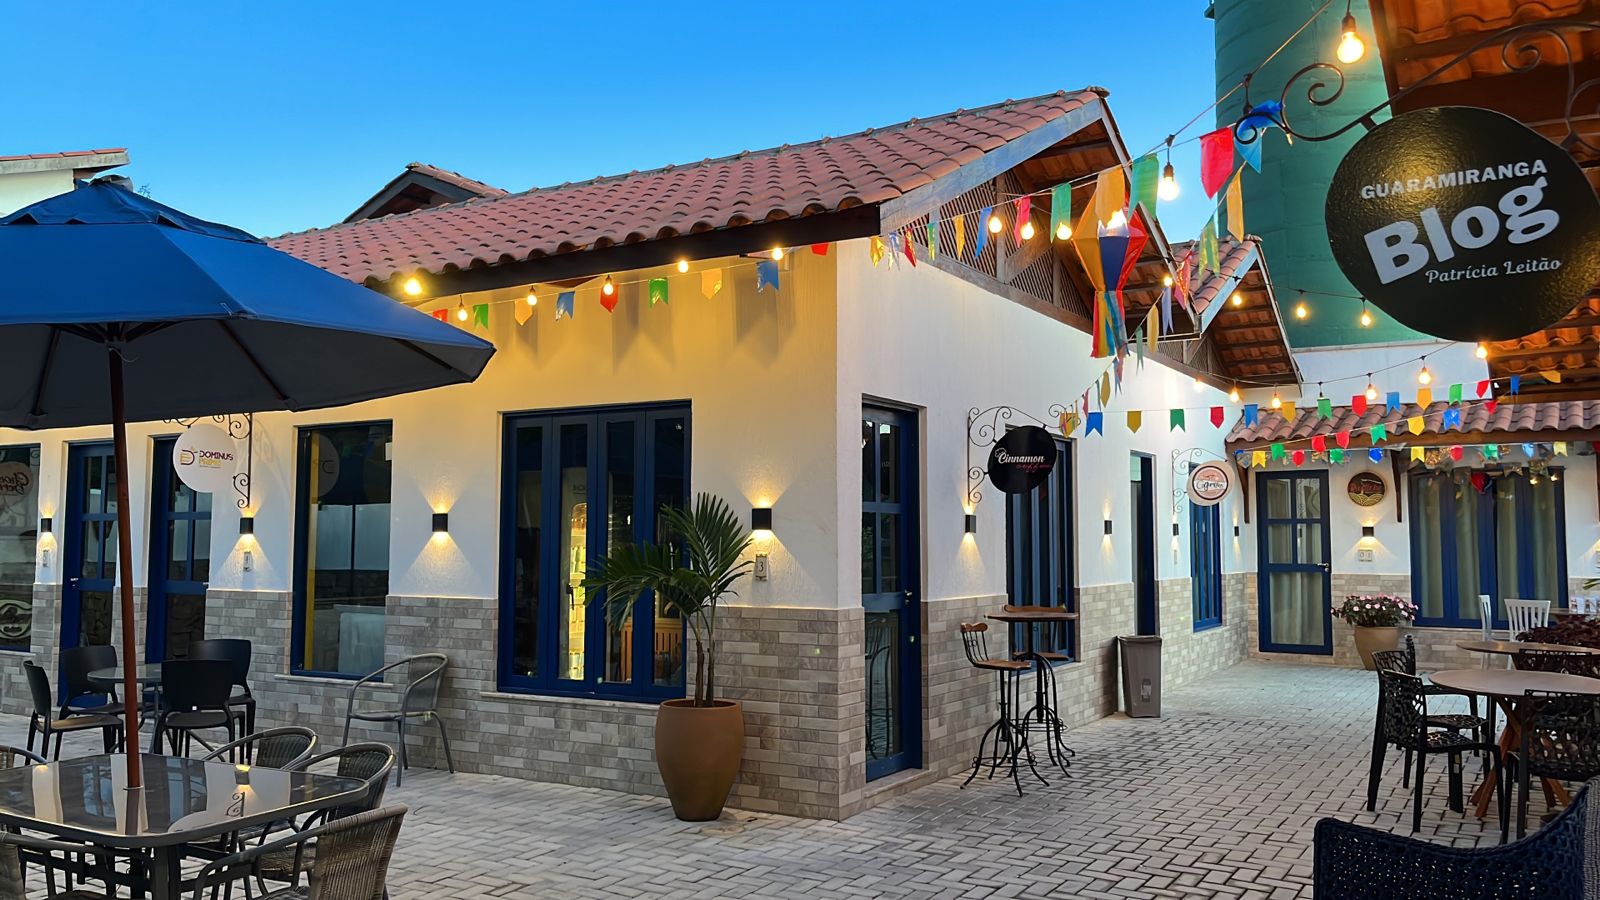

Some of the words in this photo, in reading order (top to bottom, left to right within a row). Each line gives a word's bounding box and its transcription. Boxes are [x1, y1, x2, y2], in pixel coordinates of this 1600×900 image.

[1361, 159, 1548, 199] GUARAMIRANGA
[1364, 176, 1560, 285] Blog
[1425, 265, 1498, 283] Patrícia
[1503, 258, 1562, 275] Leitão
[199, 450, 234, 461] DOMINUS
[998, 452, 1045, 464] Cinnamon
[759, 561, 764, 572] 3
